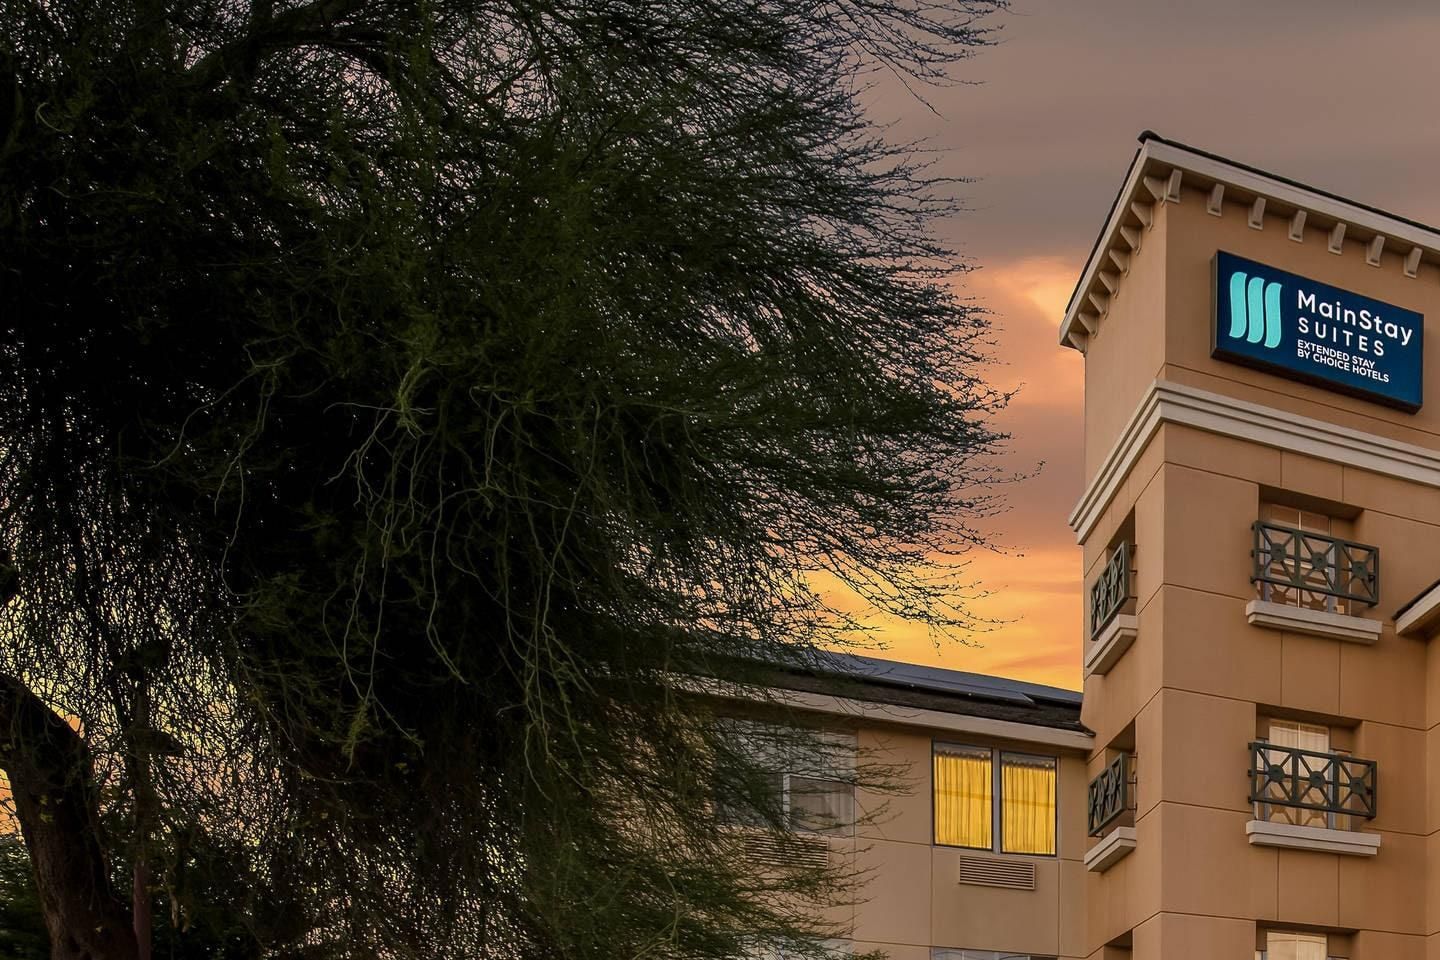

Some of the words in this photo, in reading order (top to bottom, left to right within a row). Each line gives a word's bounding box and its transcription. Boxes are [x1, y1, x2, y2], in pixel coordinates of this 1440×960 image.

[1297, 289, 1413, 346] MainStay
[1297, 339, 1350, 362] EXTENDED
[1352, 355, 1376, 370] STAY
[1298, 317, 1385, 356] SUITES
[1297, 349, 1311, 360] BY
[1312, 352, 1350, 372] CHOICE
[1352, 363, 1390, 383] HOTELS
